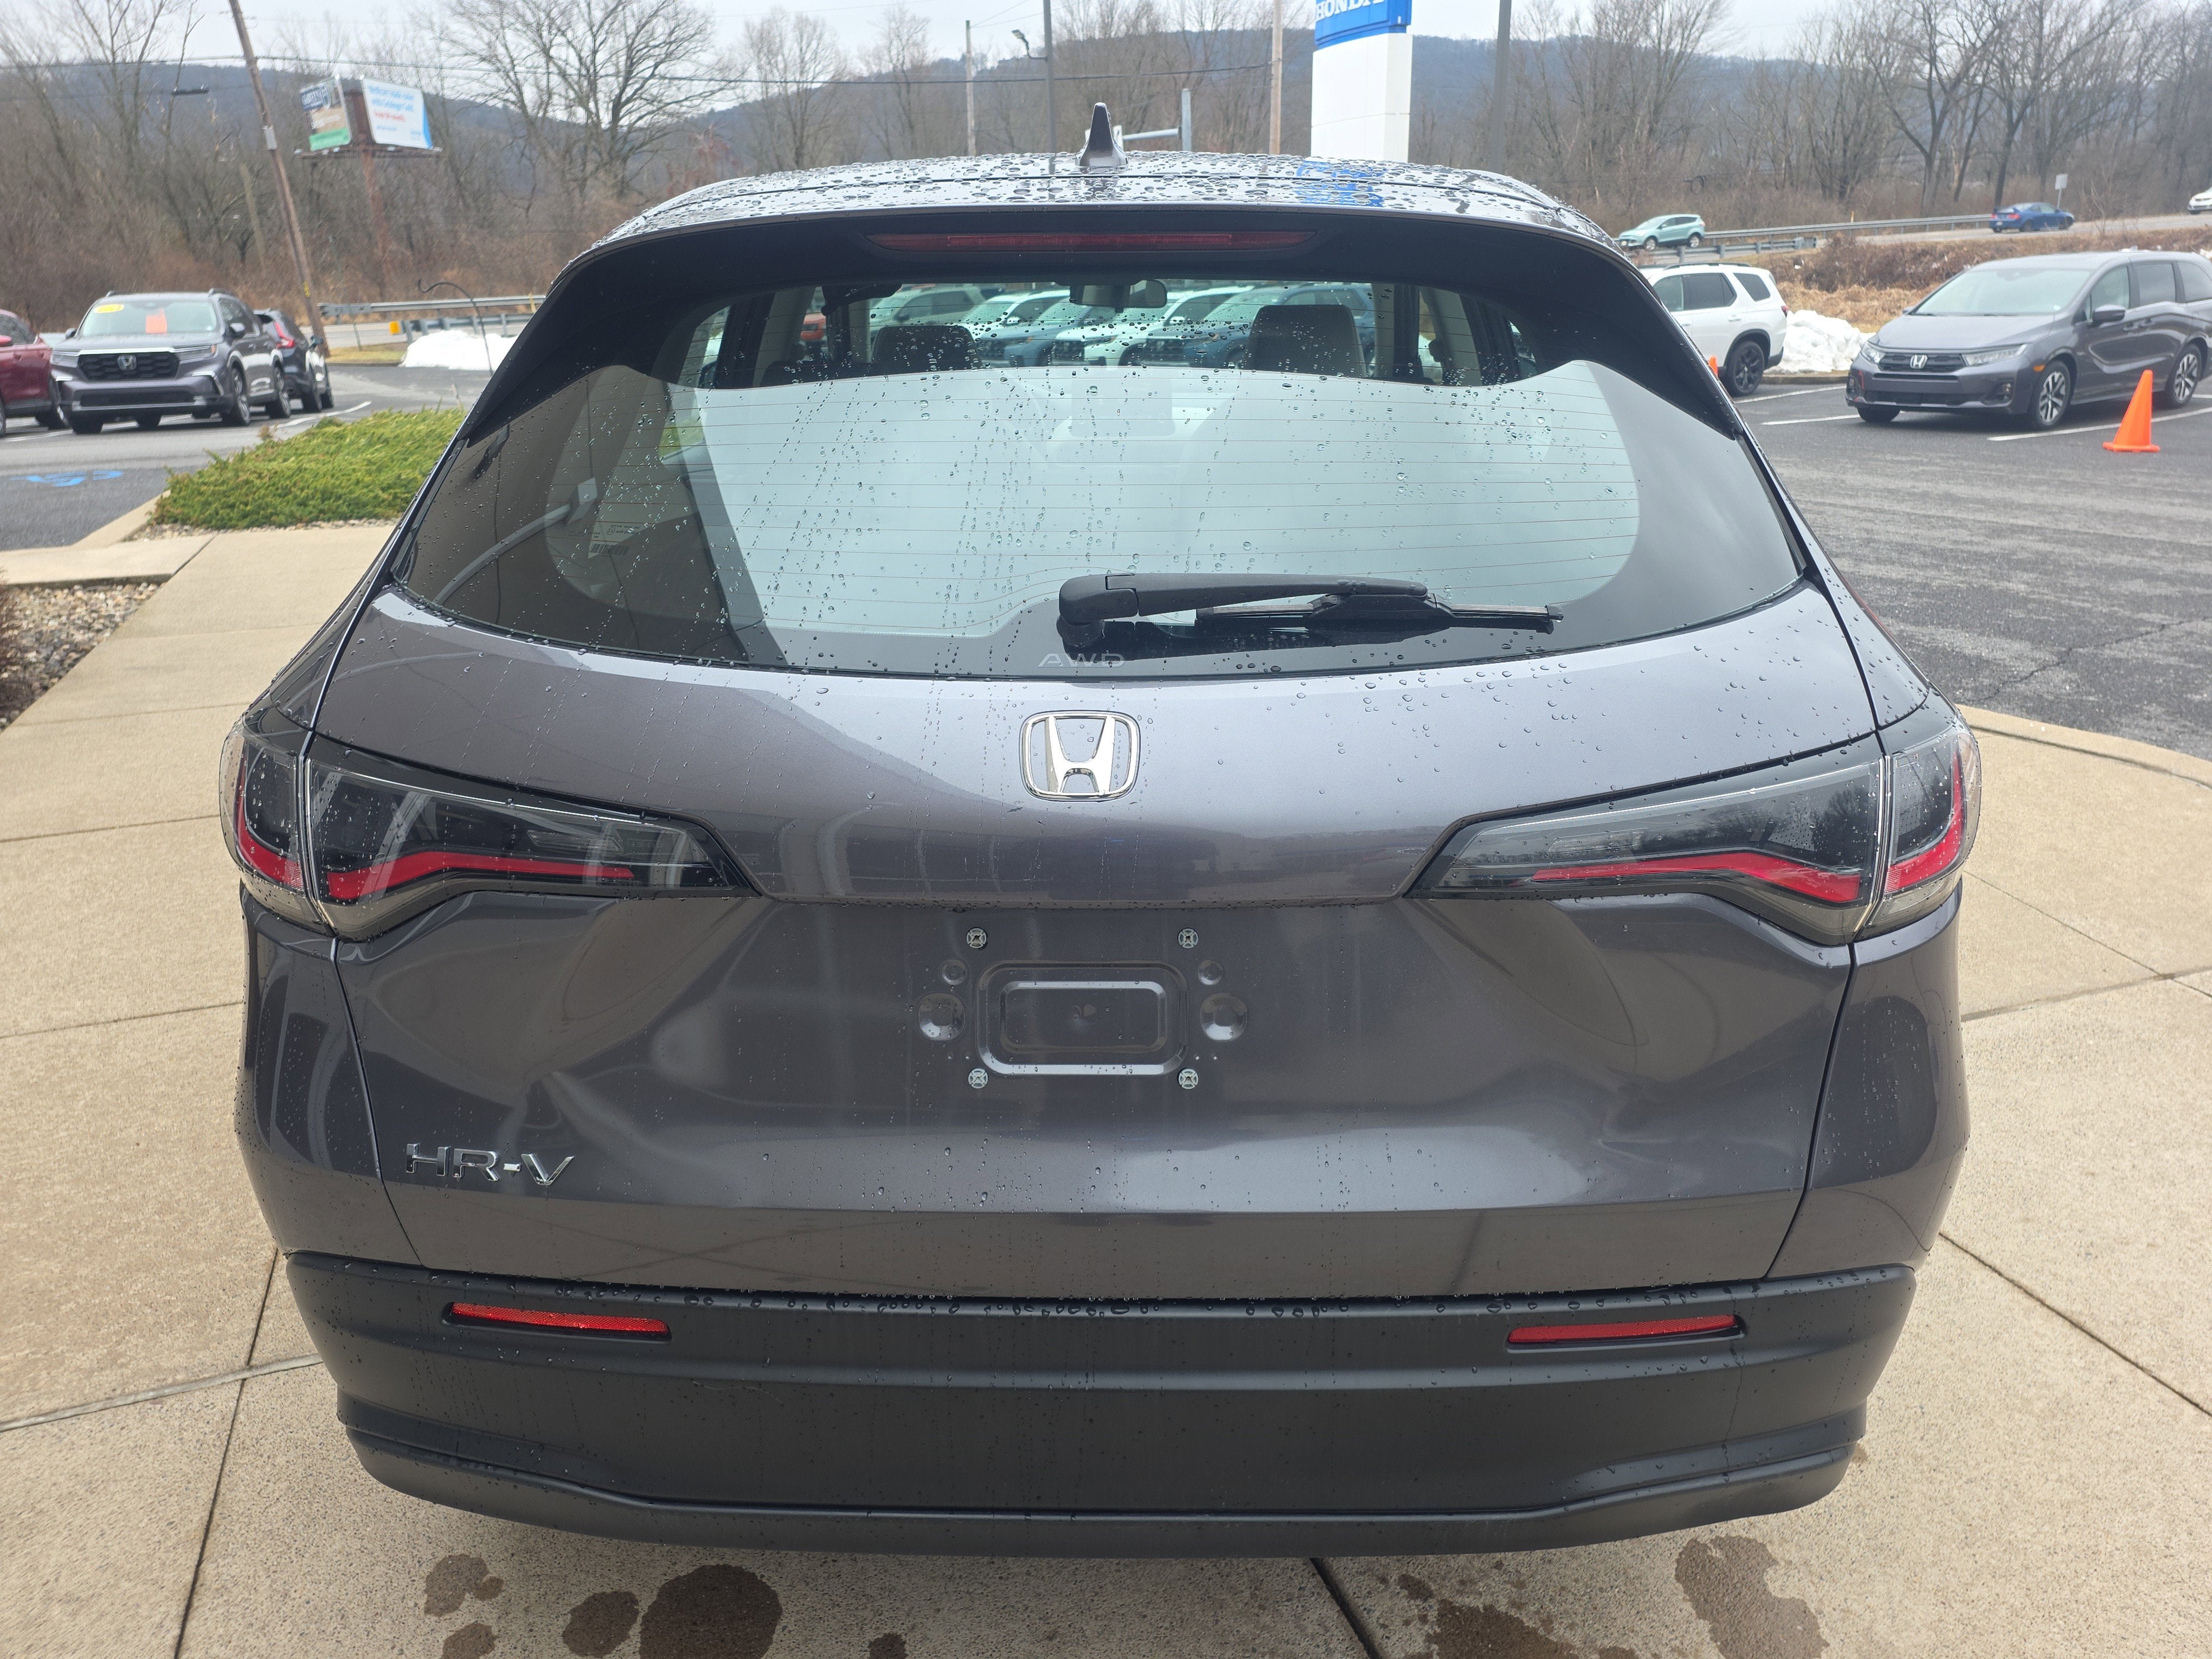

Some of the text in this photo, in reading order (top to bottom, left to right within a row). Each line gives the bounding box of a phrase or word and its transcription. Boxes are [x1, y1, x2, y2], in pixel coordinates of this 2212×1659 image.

[1316, 0, 1384, 21] HON
[1038, 653, 1125, 667] AWD
[406, 1143, 576, 1186] HR-V
